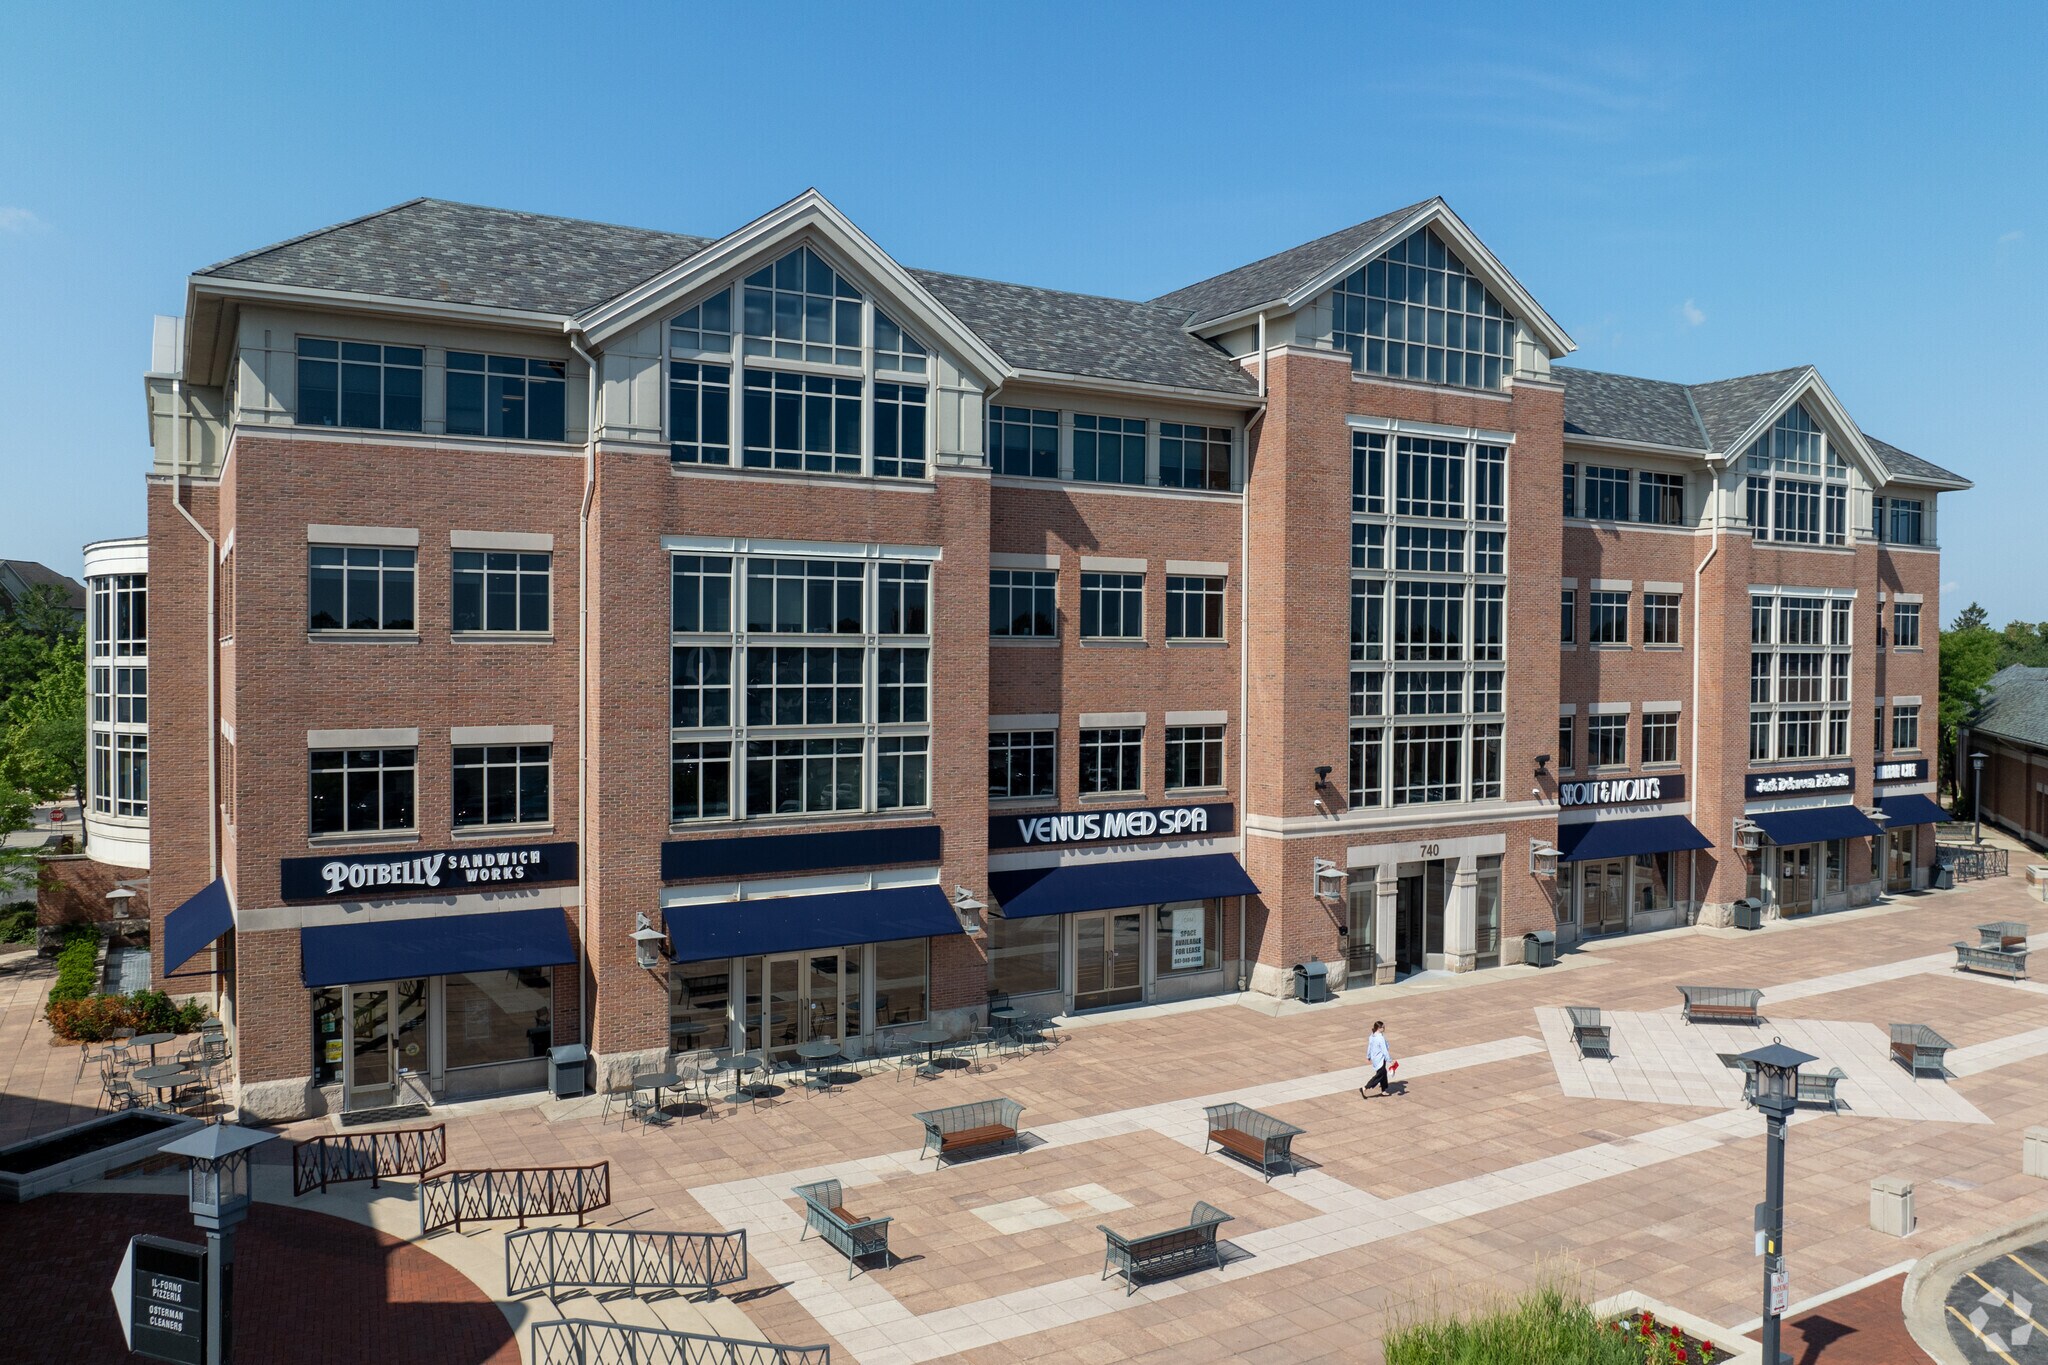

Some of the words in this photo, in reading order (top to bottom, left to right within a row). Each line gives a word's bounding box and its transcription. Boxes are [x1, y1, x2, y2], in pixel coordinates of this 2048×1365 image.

[1561, 782, 1600, 806] SCOUT
[1600, 781, 1610, 803] &
[1018, 814, 1100, 844] VENUS
[1103, 811, 1157, 838] MED
[1159, 807, 1207, 834] SPA
[1420, 844, 1439, 858] 740
[321, 852, 446, 894] POTBELLY
[448, 850, 541, 869] SANDWICH
[465, 866, 525, 883] WORKS
[1180, 929, 1197, 937] SPACE
[1175, 938, 1202, 947] AVAILABLE
[1186, 946, 1201, 954] LEASE
[151, 1278, 182, 1293] IL-FORNO
[152, 1288, 182, 1303] PIZZERIA
[148, 1305, 184, 1321] OSTERMAN
[149, 1316, 183, 1332] CLEANERS
